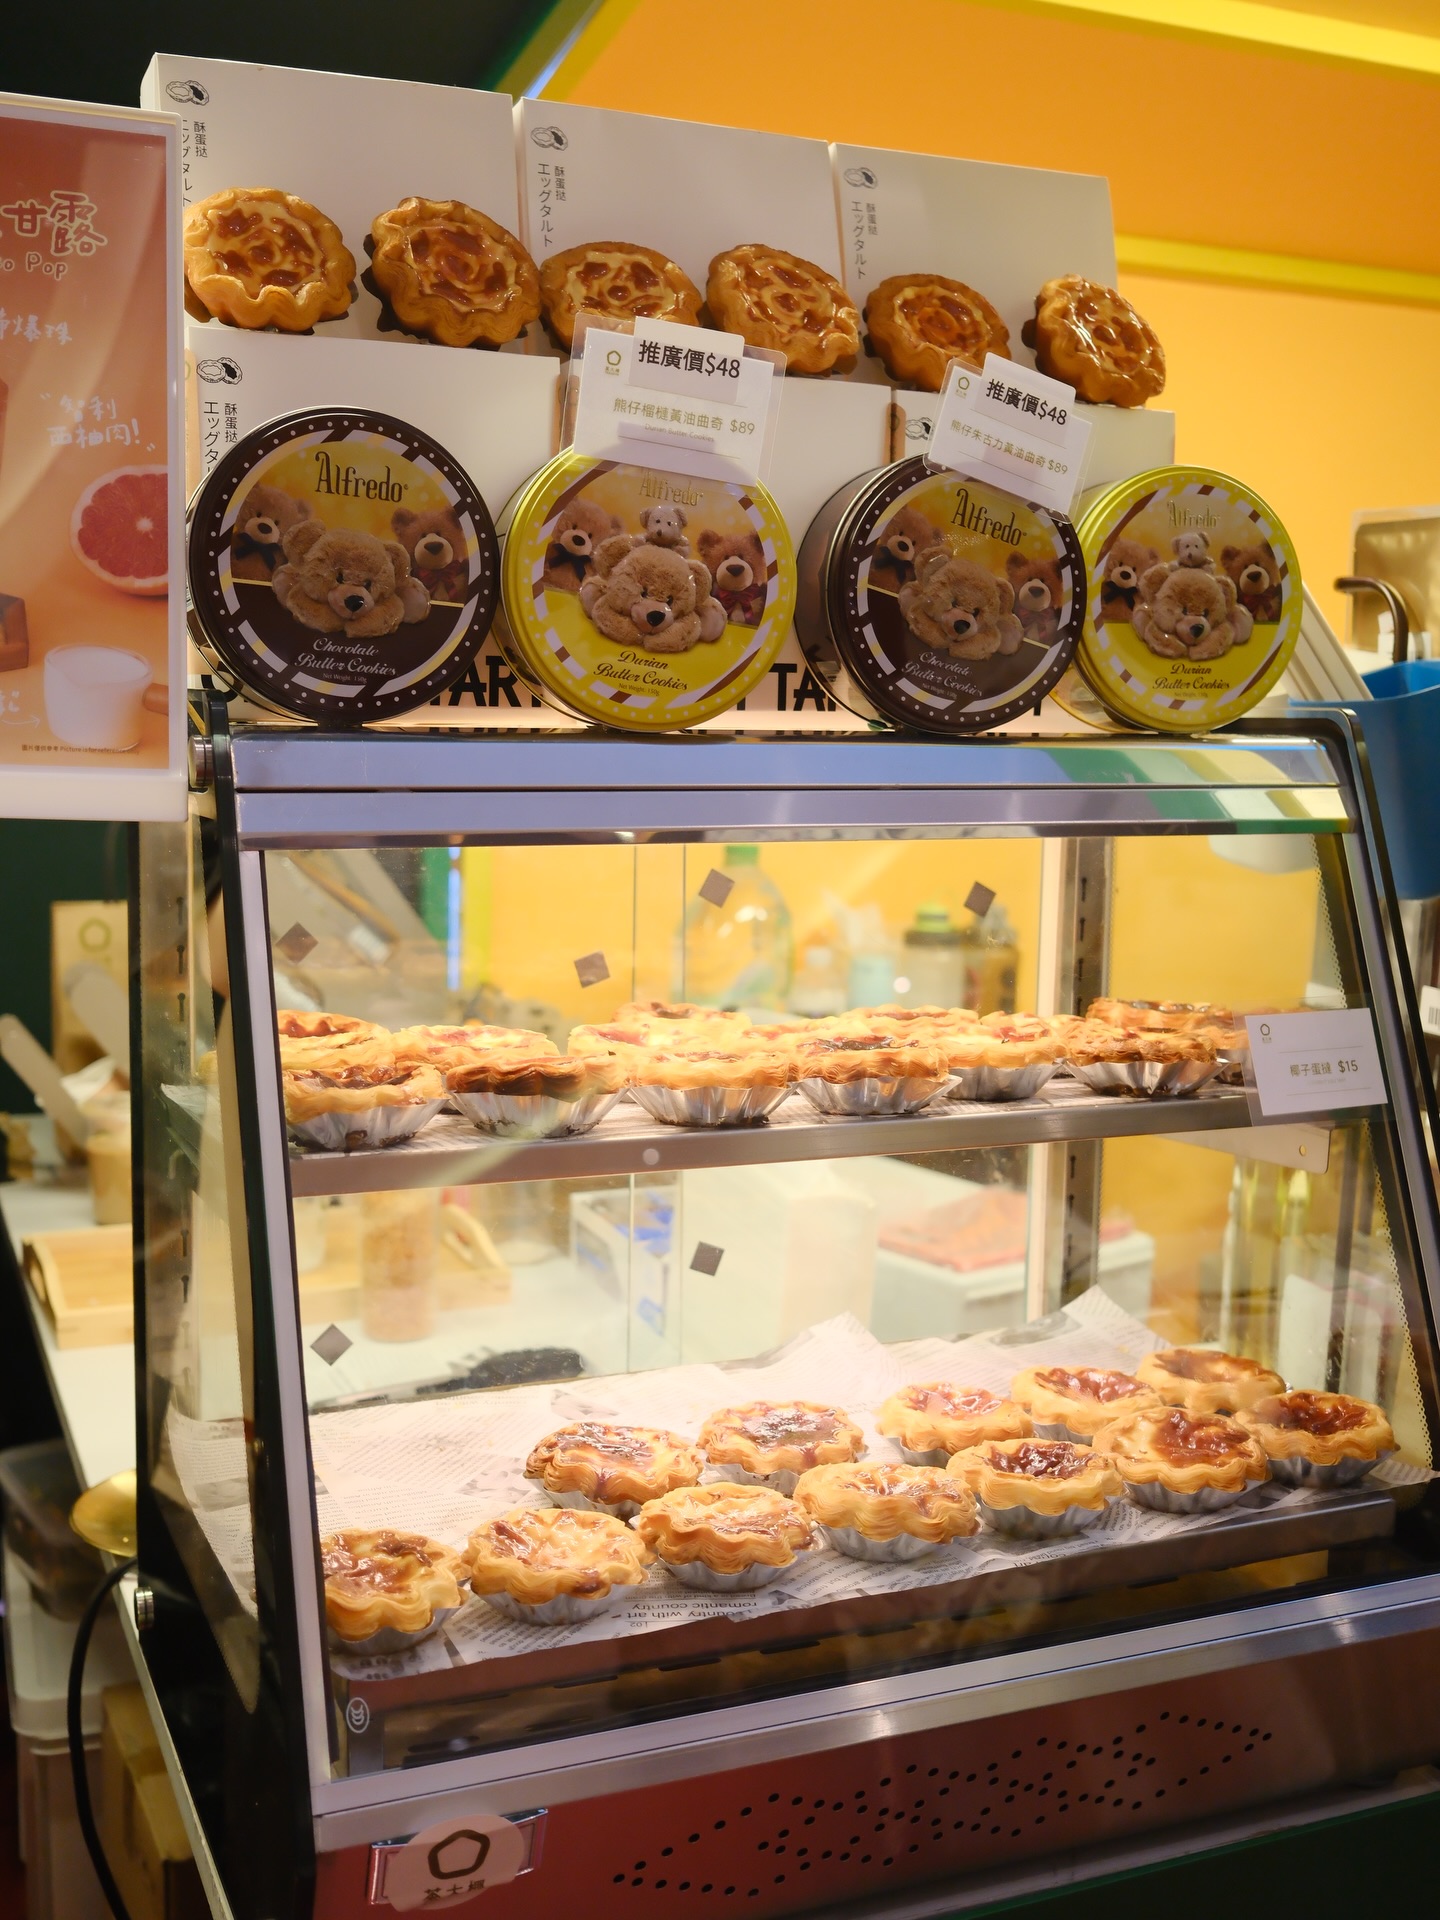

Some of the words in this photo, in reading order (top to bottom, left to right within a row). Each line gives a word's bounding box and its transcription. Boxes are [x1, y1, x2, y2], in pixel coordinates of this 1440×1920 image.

[538, 163, 553, 247] エッグタルト
[851, 201, 866, 279] エッグタルト
[26, 252, 68, 281] Pop
[638, 339, 741, 378] 推廣價$48
[985, 378, 1068, 425] 推廣價$48
[203, 401, 220, 473] エッグタ
[730, 418, 755, 435] $89
[315, 451, 404, 503] Alfredo
[1047, 460, 1068, 474] $89
[639, 468, 699, 507] Alfredo
[951, 488, 1022, 546] Alfredo
[313, 638, 379, 656] Chocolate
[618, 650, 668, 670] Durian
[294, 652, 345, 671] Butter
[347, 657, 396, 675] Cookies
[593, 662, 640, 682] Butter
[642, 670, 688, 691] Cookies
[919, 651, 972, 676] Chocolate
[1170, 663, 1212, 675] Durian
[901, 661, 943, 683] Butter
[943, 675, 982, 697] Cookies
[1152, 676, 1191, 690] Butter
[1192, 676, 1230, 690] Cookies
[1338, 1059, 1359, 1073] $15
[652, 1611, 682, 1619] with
[687, 1610, 741, 1618] ountry
